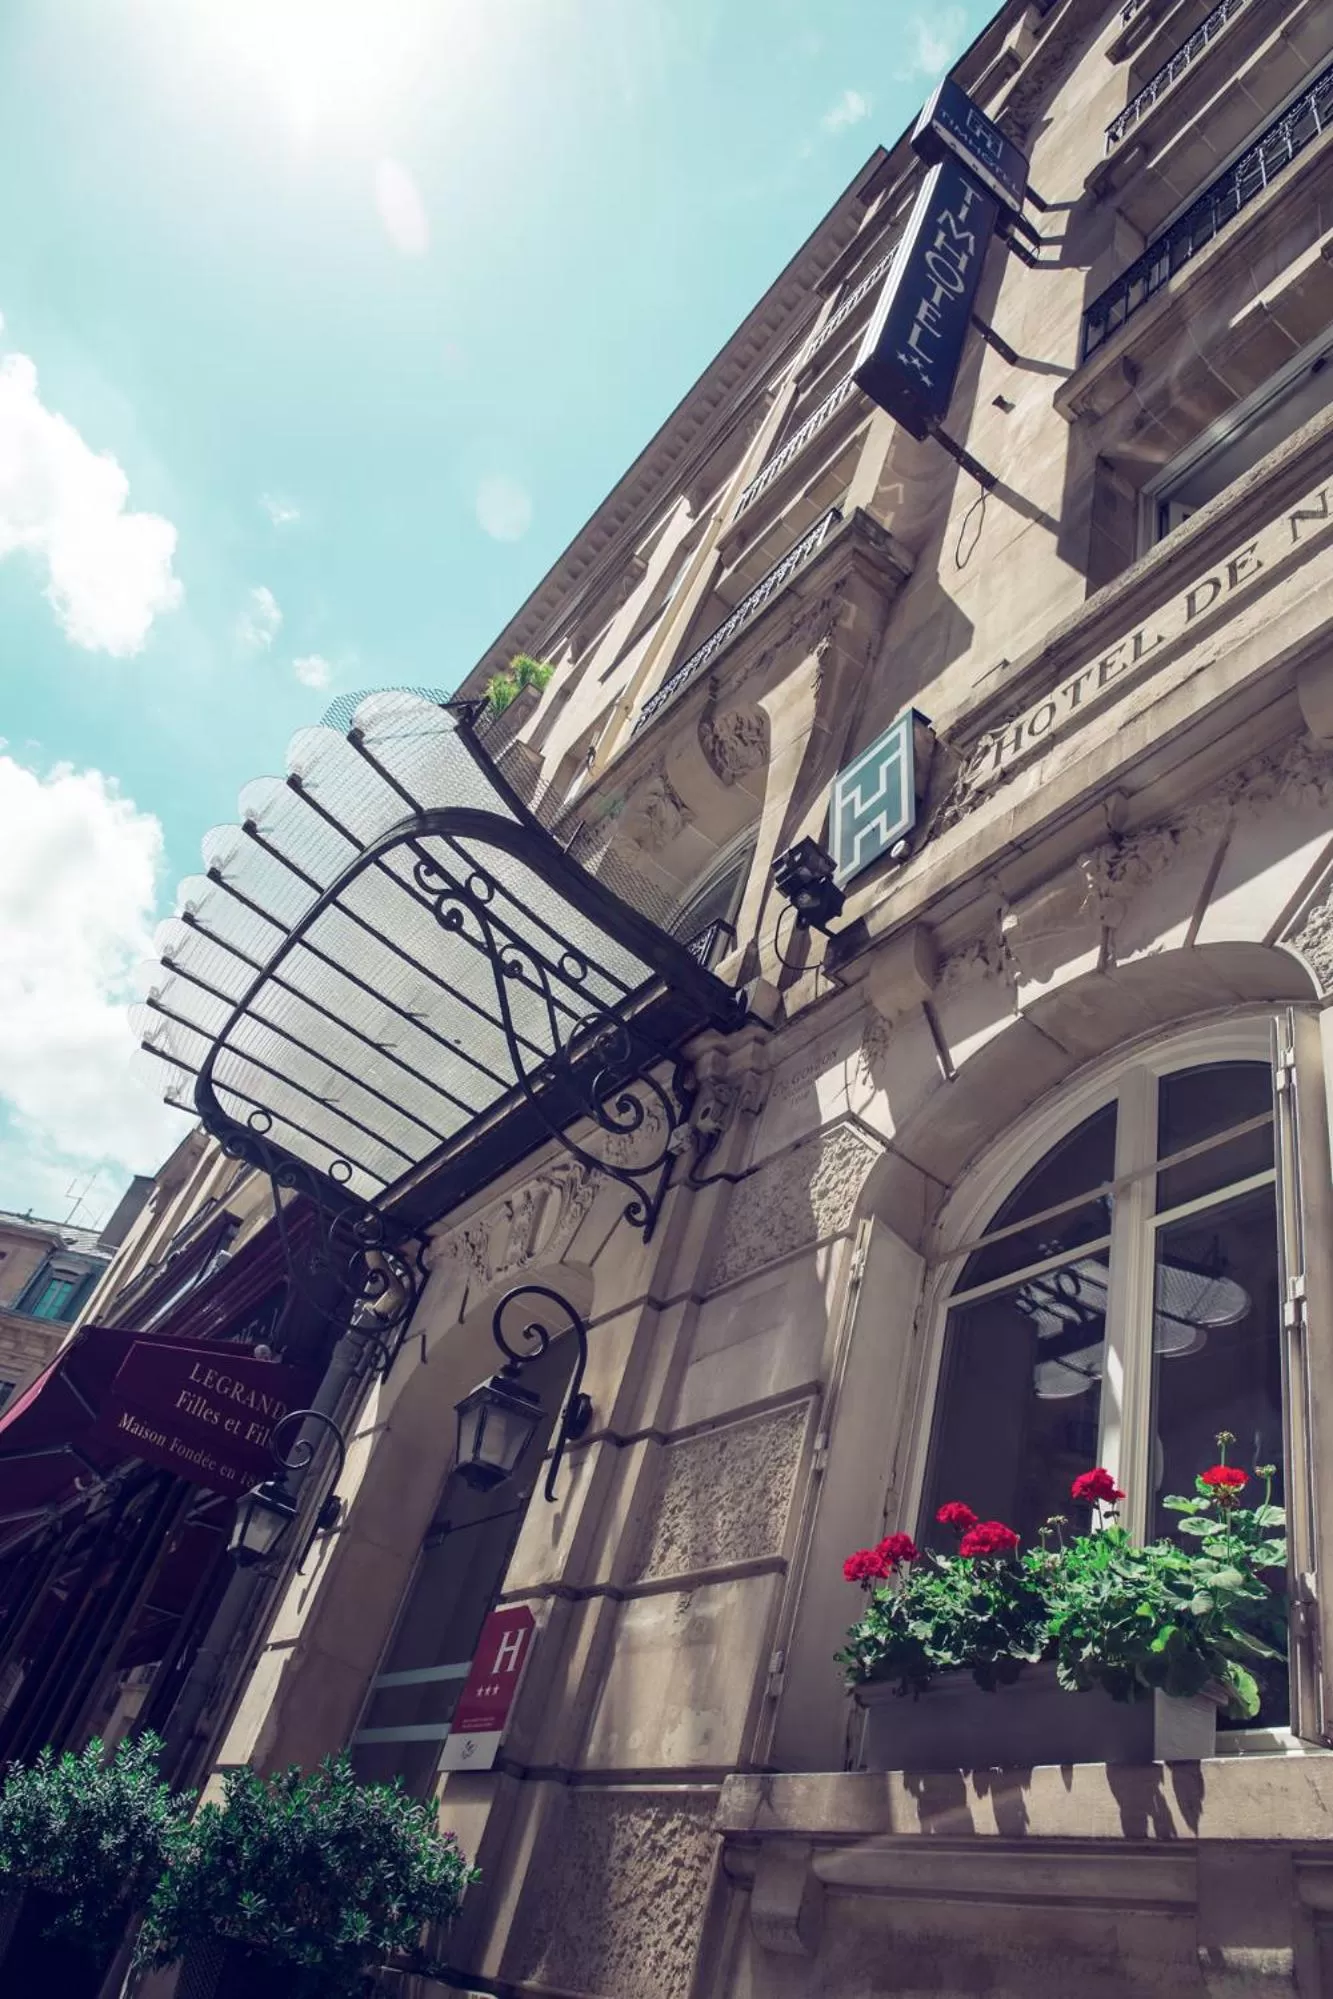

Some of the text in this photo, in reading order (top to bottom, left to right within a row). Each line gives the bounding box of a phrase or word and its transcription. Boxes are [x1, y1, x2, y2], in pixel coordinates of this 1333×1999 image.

[907, 176, 984, 364] TIMHOTEL
[992, 627, 1166, 770] HOTEL
[1184, 541, 1264, 624] DE
[173, 1389, 271, 1448] Filles et Fil
[188, 1362, 287, 1420] LEGRAND
[117, 1412, 168, 1447] Maison
[168, 1437, 217, 1470] Fondée
[220, 1464, 236, 1479] en
[491, 1627, 528, 1675] H
